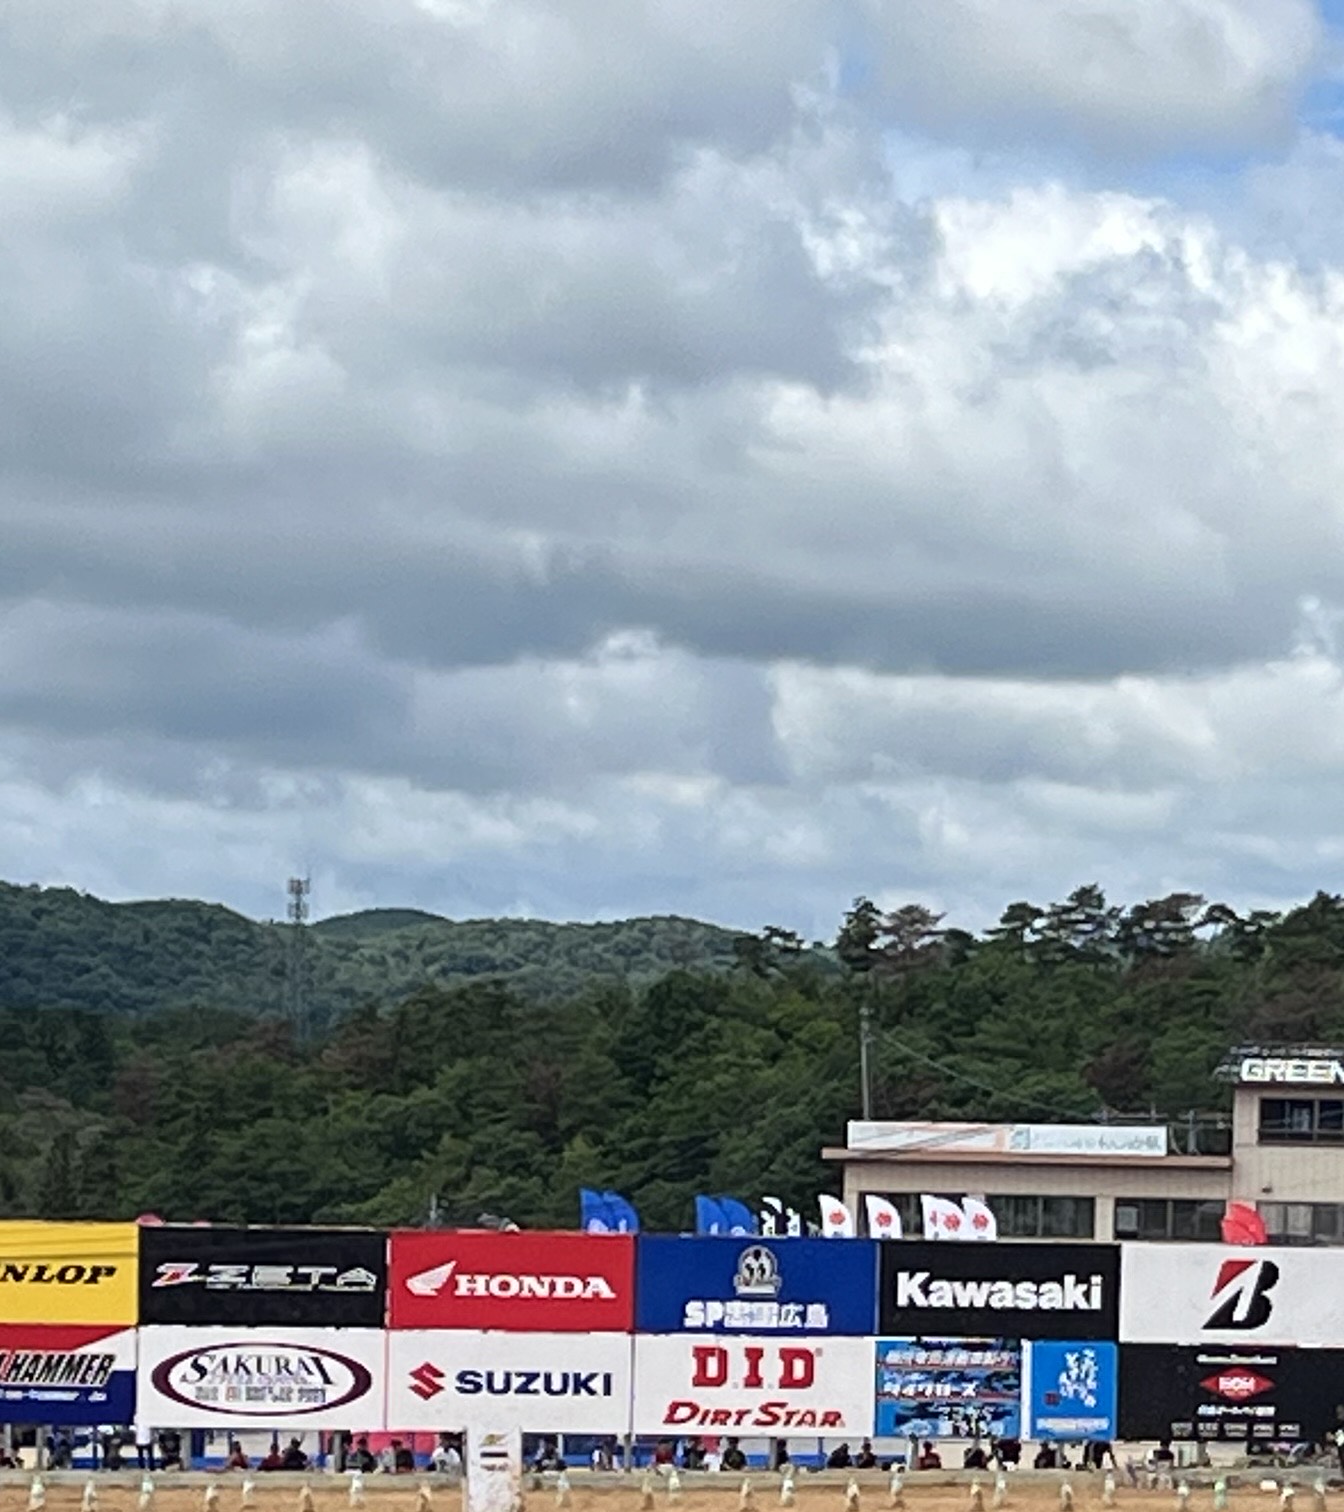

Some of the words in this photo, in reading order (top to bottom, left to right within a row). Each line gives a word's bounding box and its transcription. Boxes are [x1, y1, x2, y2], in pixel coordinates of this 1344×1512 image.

[455, 1274, 616, 1298] HONDA
[896, 1272, 1104, 1311] Kawasaki
[6, 1353, 117, 1385] HAMMER
[179, 1354, 335, 1385] SAKURAI
[455, 1370, 612, 1397] SUZUKI
